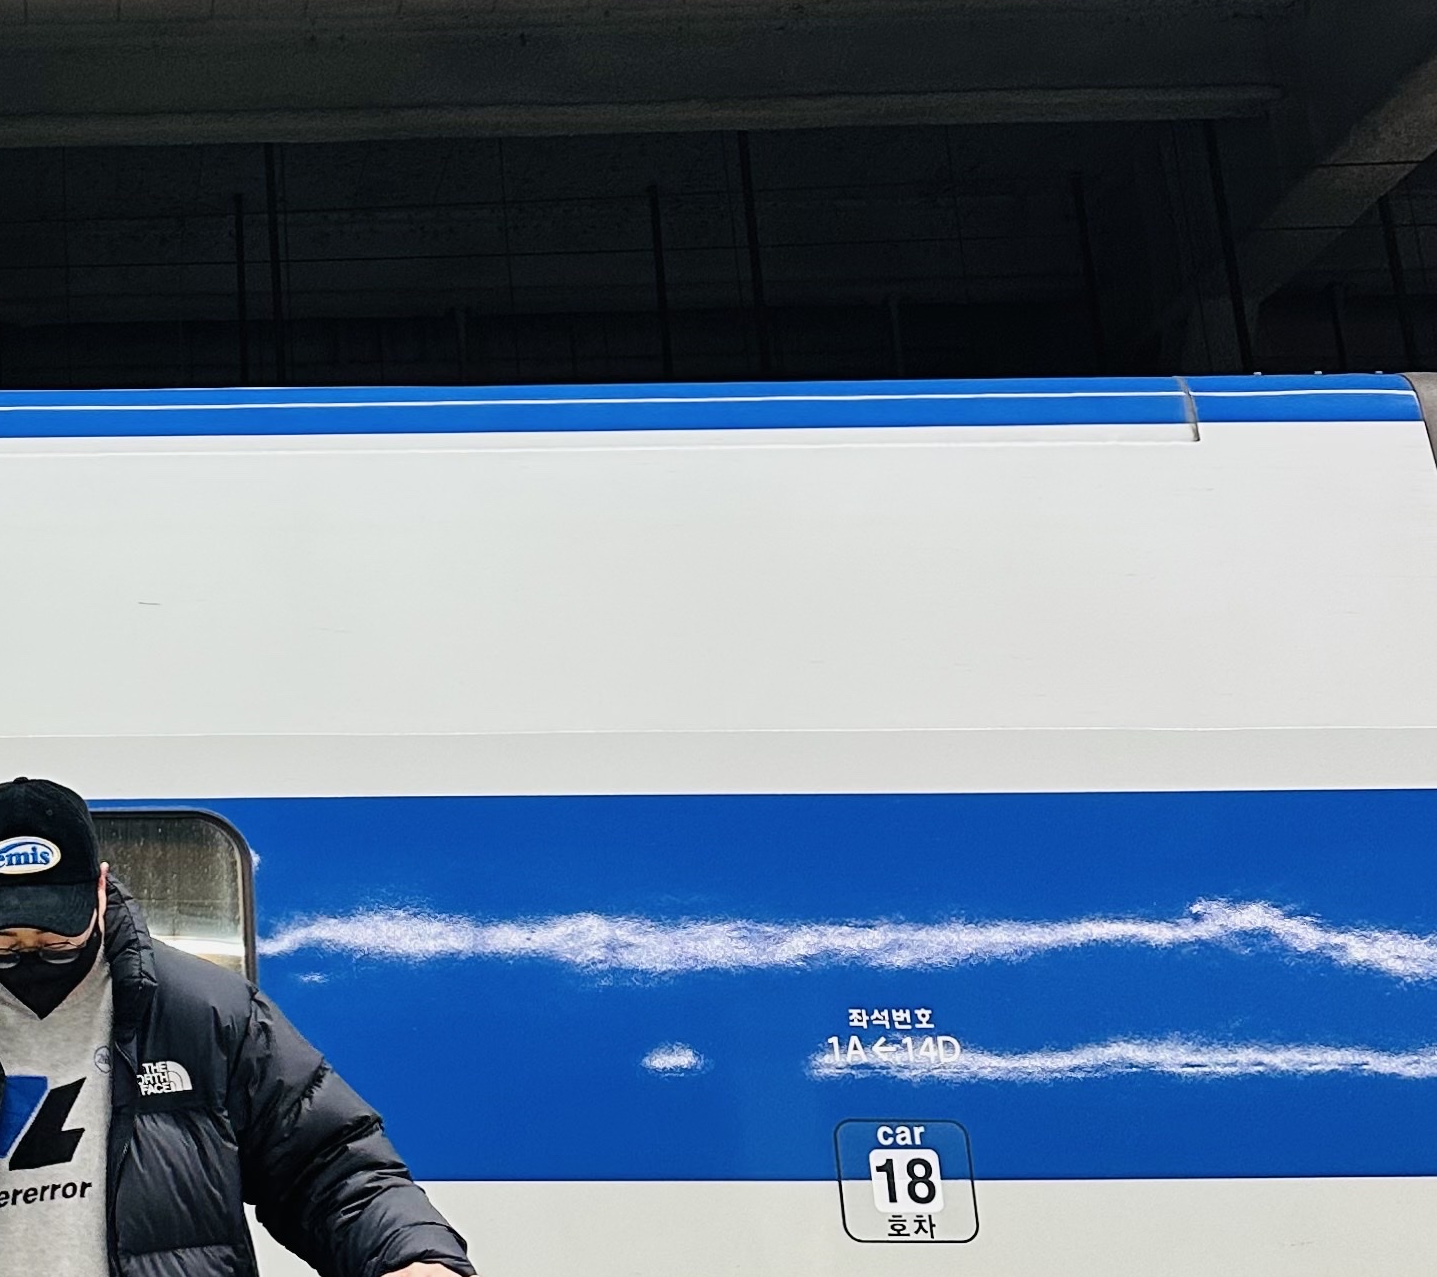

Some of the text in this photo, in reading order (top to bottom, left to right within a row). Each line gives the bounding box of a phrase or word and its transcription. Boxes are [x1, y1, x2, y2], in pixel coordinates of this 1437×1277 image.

[848, 1008, 935, 1029] 좌석번호
[142, 1061, 167, 1073] THE
[138, 1083, 172, 1095] FACE
[876, 1125, 925, 1145] car
[875, 1158, 936, 1204] 18
[887, 1214, 937, 1239] 호차
